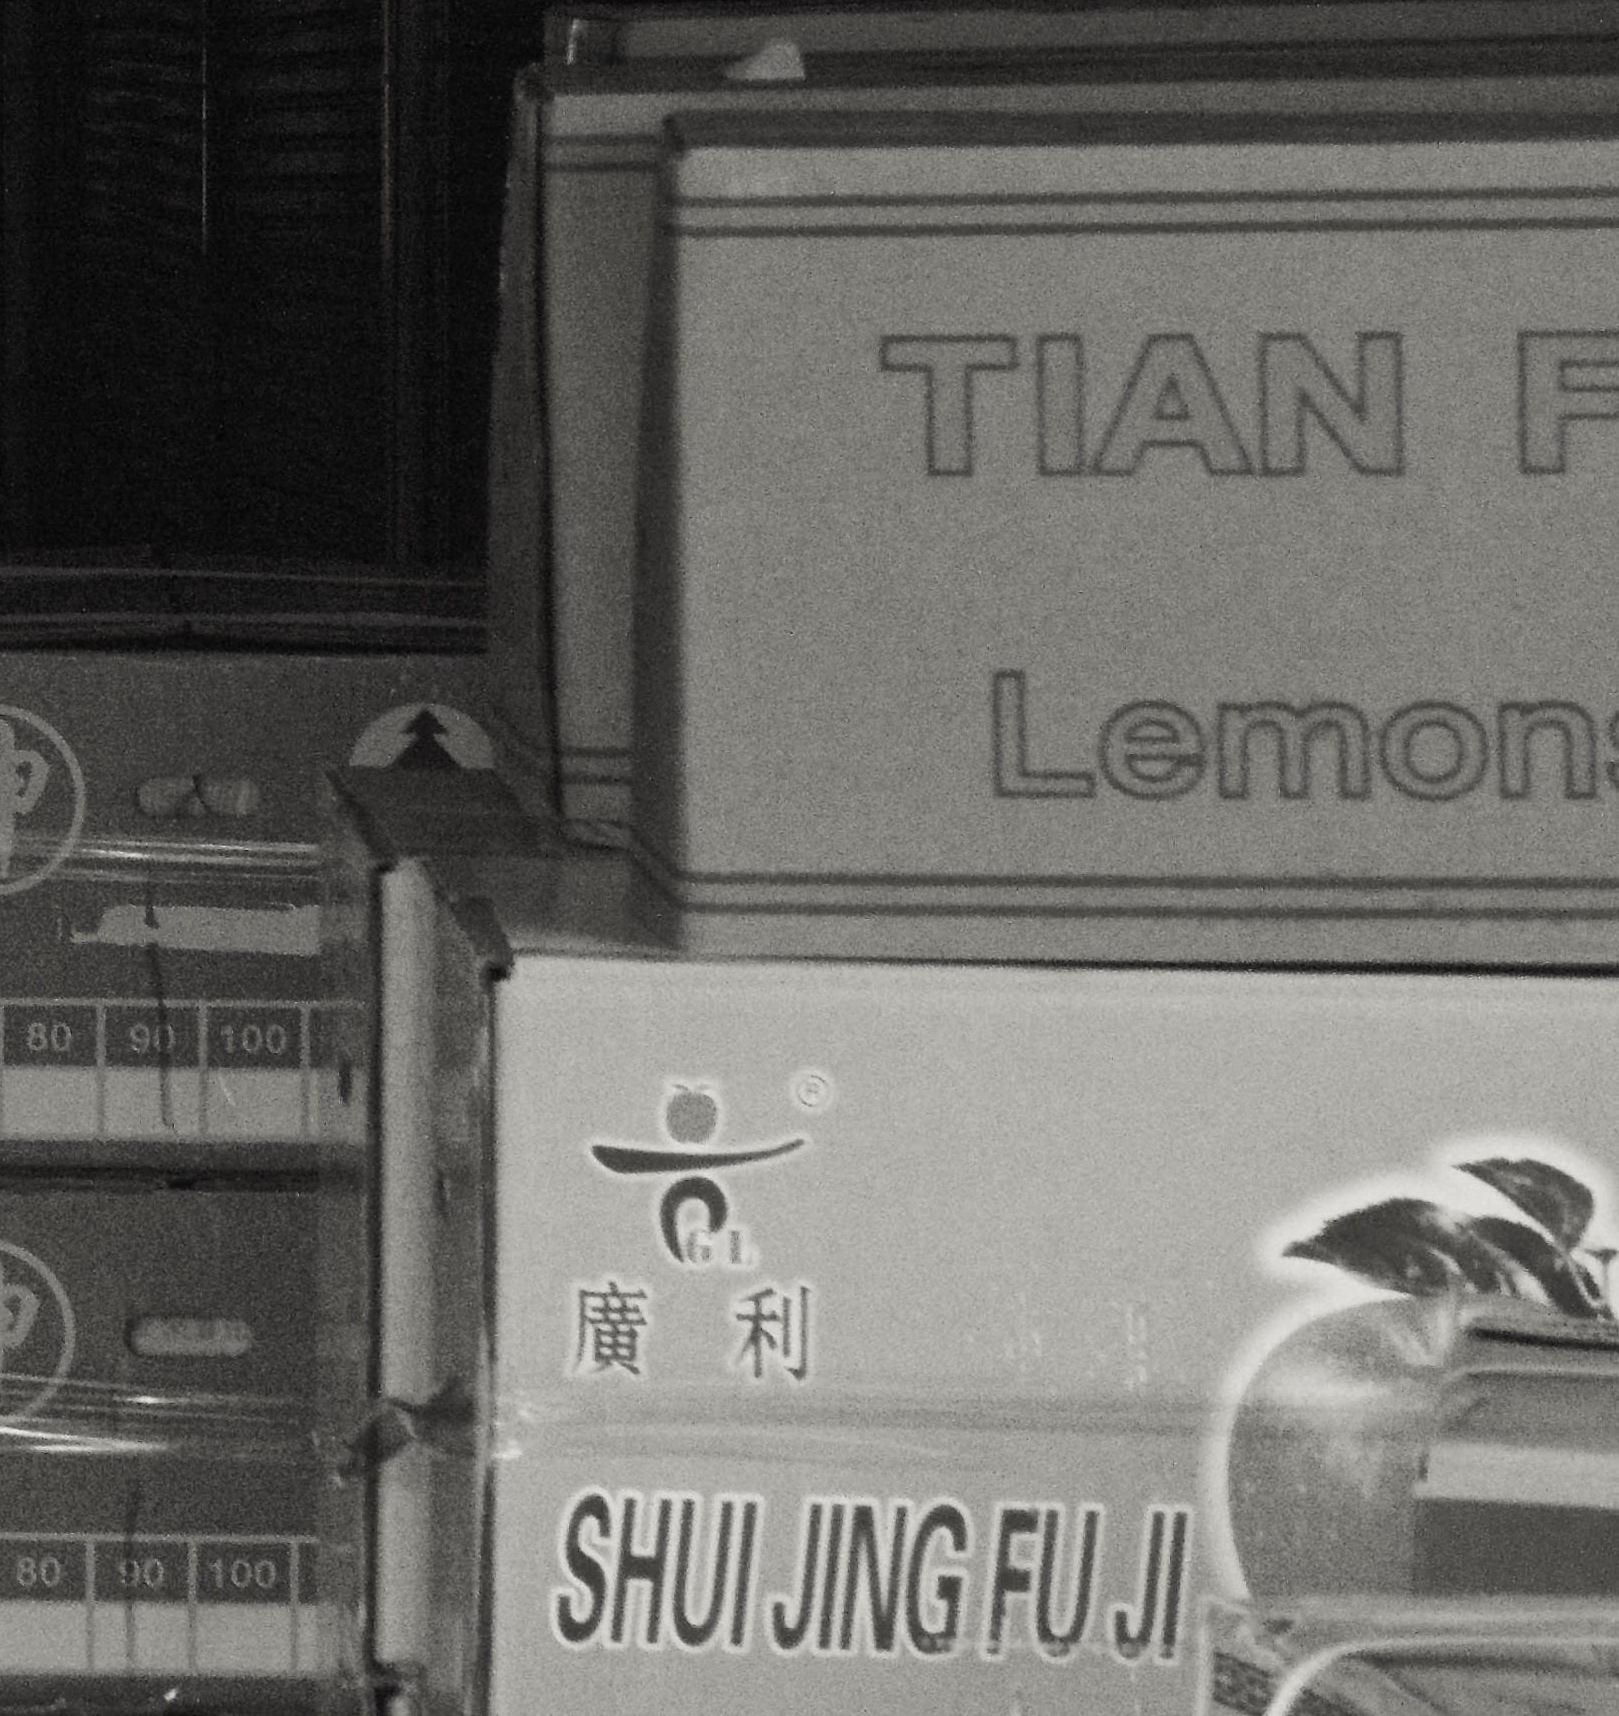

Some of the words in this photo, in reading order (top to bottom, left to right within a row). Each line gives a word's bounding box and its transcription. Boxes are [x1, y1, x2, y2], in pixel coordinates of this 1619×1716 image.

[879, 332, 1404, 478] TIAN
[991, 669, 1619, 802] Lemon
[26, 1021, 73, 1052] 80
[128, 1023, 176, 1054] 90
[220, 1024, 287, 1055] 100
[574, 1280, 812, 1382] 廣利
[16, 1555, 62, 1588] 80
[119, 1557, 166, 1590] 90
[210, 1558, 277, 1590] 100
[558, 1493, 760, 1648] SHUI
[772, 1502, 970, 1656] JING
[988, 1506, 1104, 1657] FU
[1114, 1509, 1190, 1660] JI
